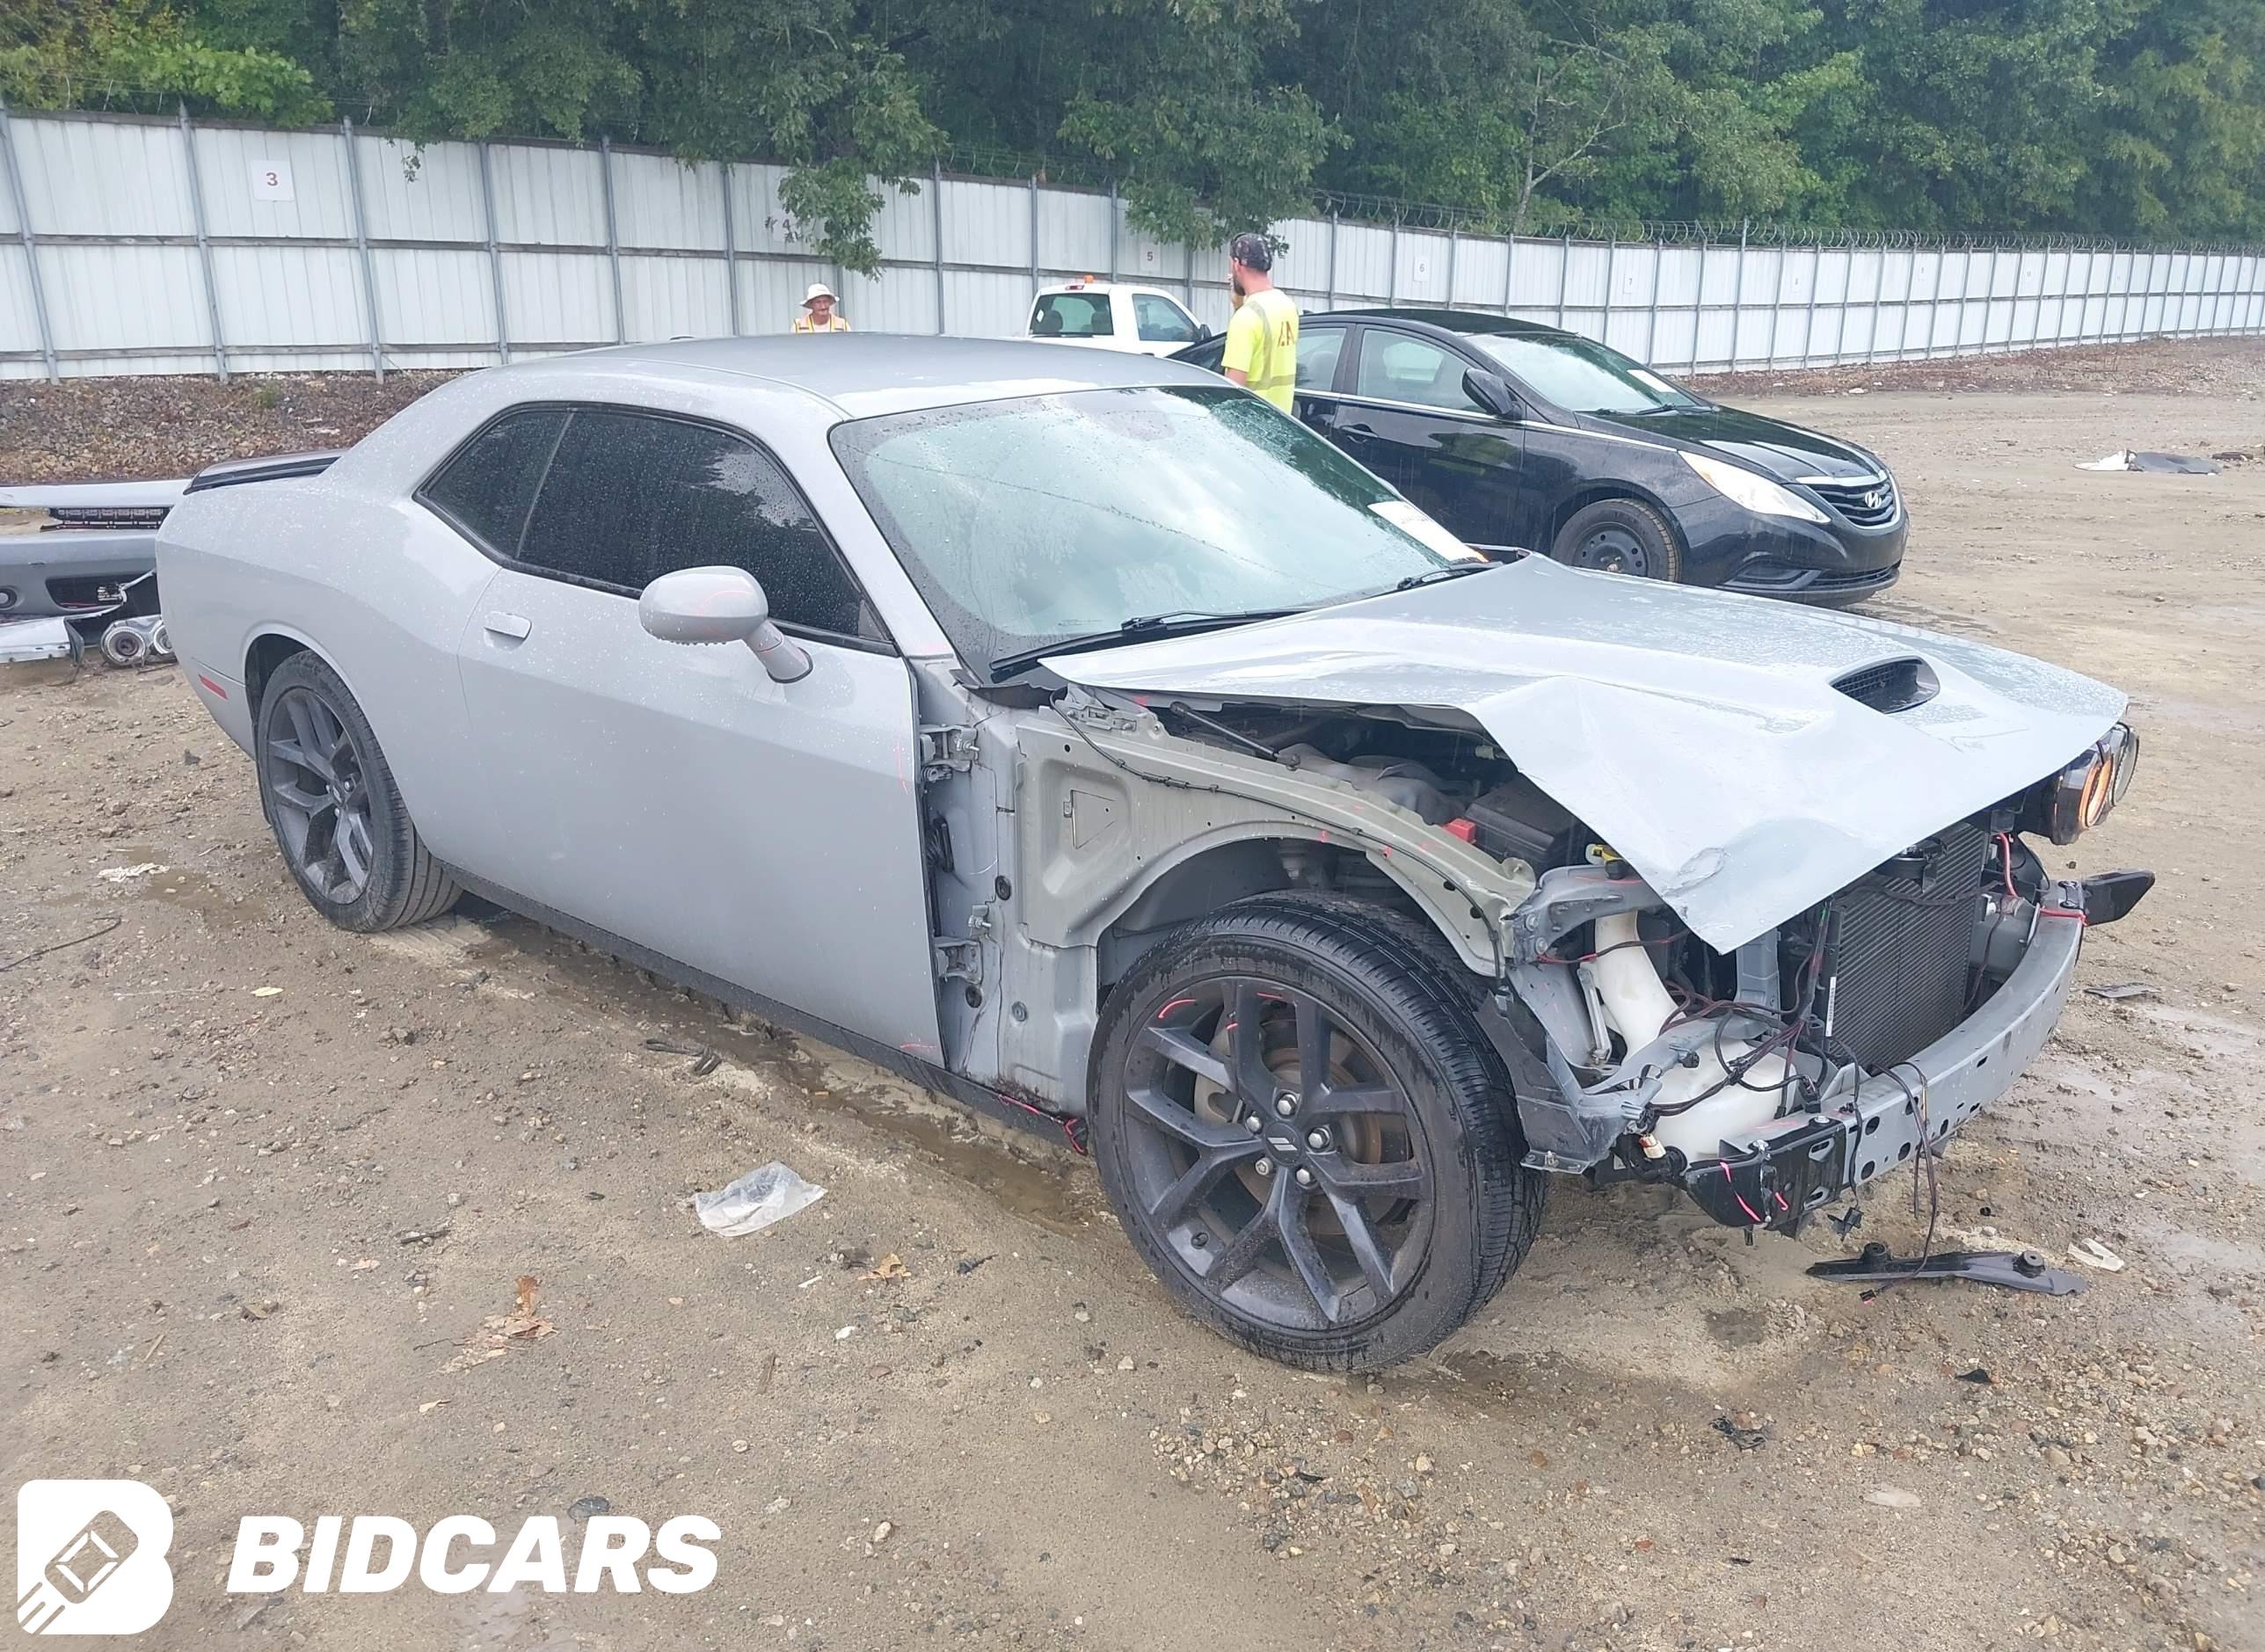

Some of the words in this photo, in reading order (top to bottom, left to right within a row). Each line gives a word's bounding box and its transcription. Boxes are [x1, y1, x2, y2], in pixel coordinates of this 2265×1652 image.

[266, 171, 279, 186] 3
[1147, 251, 1154, 262] 5
[1419, 263, 1425, 273] 6
